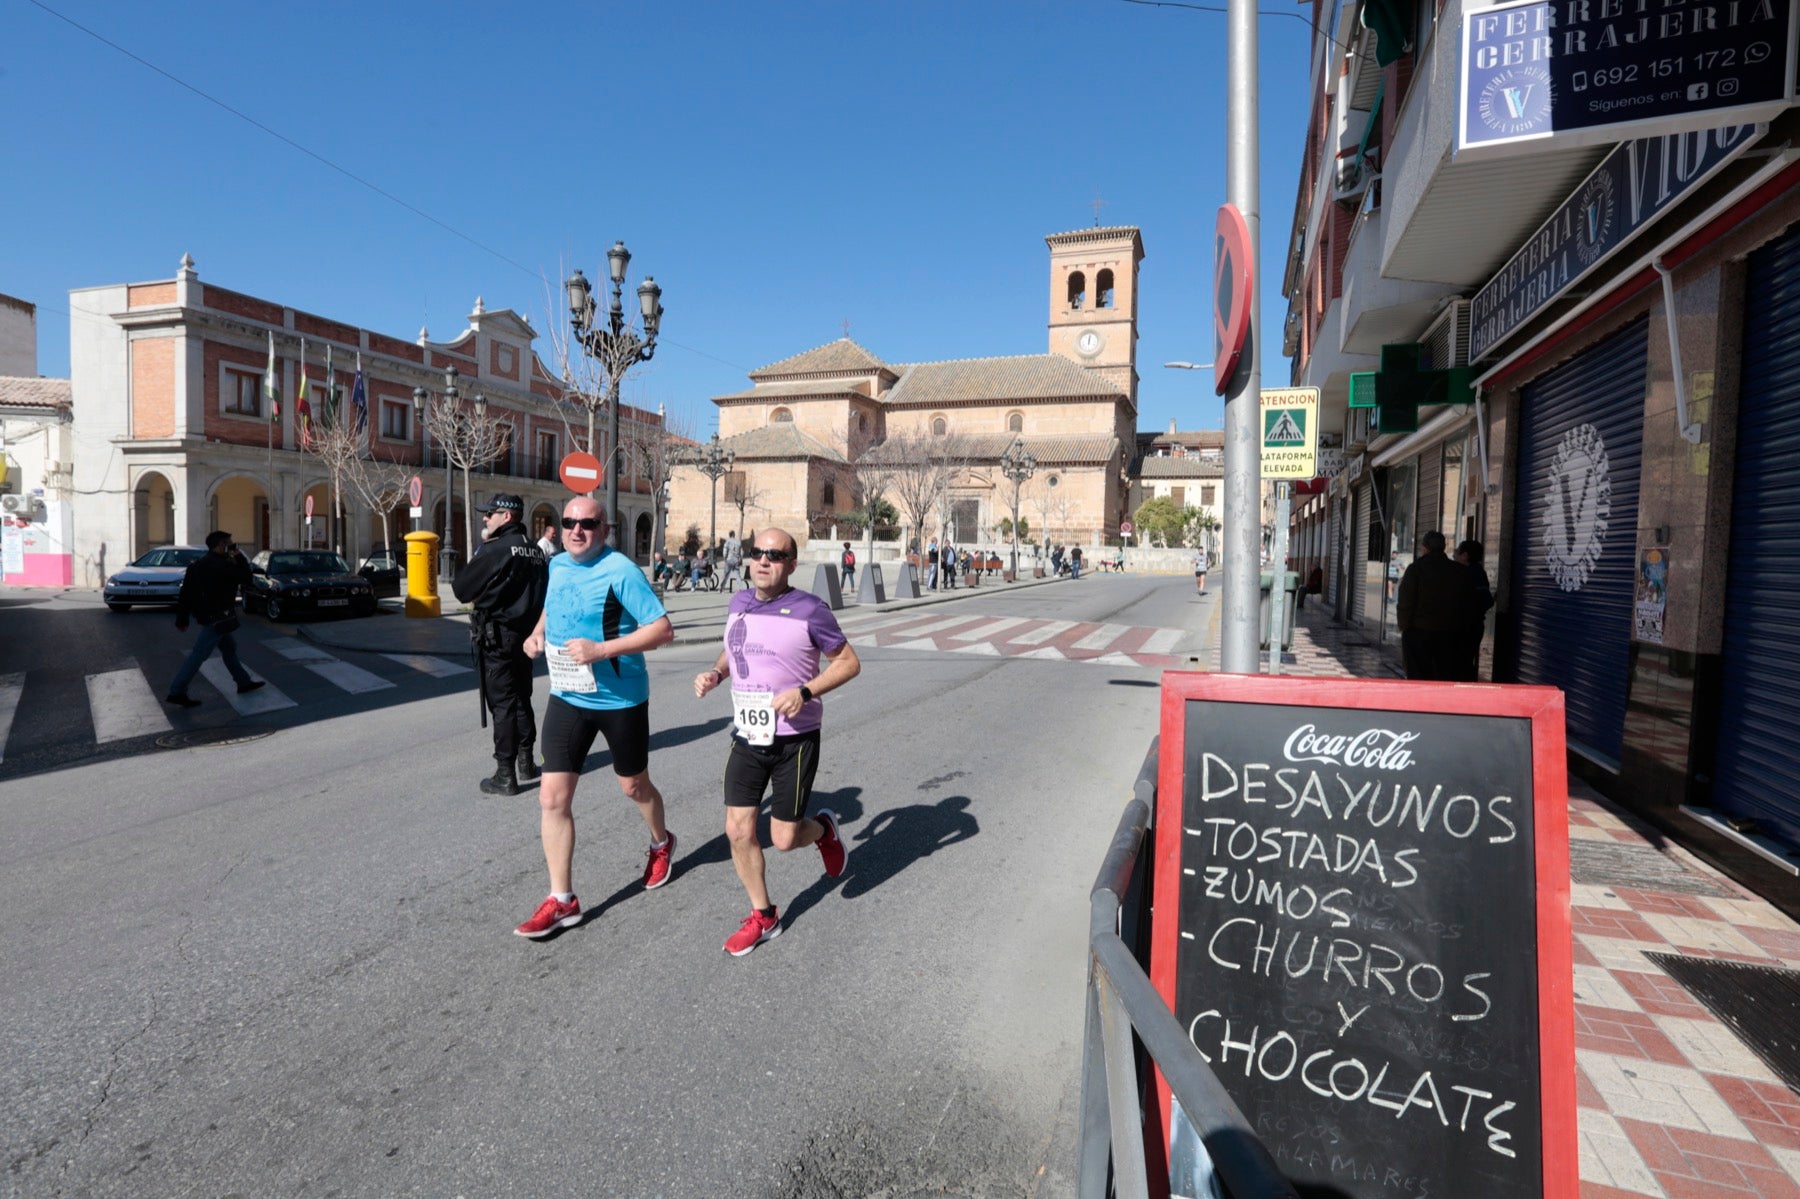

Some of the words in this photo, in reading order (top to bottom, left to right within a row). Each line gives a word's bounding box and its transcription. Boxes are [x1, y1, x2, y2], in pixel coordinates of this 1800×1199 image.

[1477, 0, 1777, 69] CERRAJERIA
[1593, 64, 1639, 88] 692
[1648, 56, 1684, 79] 151
[1694, 48, 1736, 71] 172
[1473, 207, 1571, 325] FERRETERIA
[1473, 251, 1569, 355] CERRAJERIA
[1260, 394, 1316, 405] ATENCION
[1260, 452, 1313, 461] LATAFORMA
[1263, 464, 1303, 473] ELEVADA
[739, 708, 770, 726] 169
[1283, 723, 1420, 771] Coca-Cola
[1201, 752, 1517, 845] DESAYUNOS
[1208, 917, 1492, 1021] CHURROS
[1189, 1009, 1518, 1159] CHOCOLATE
